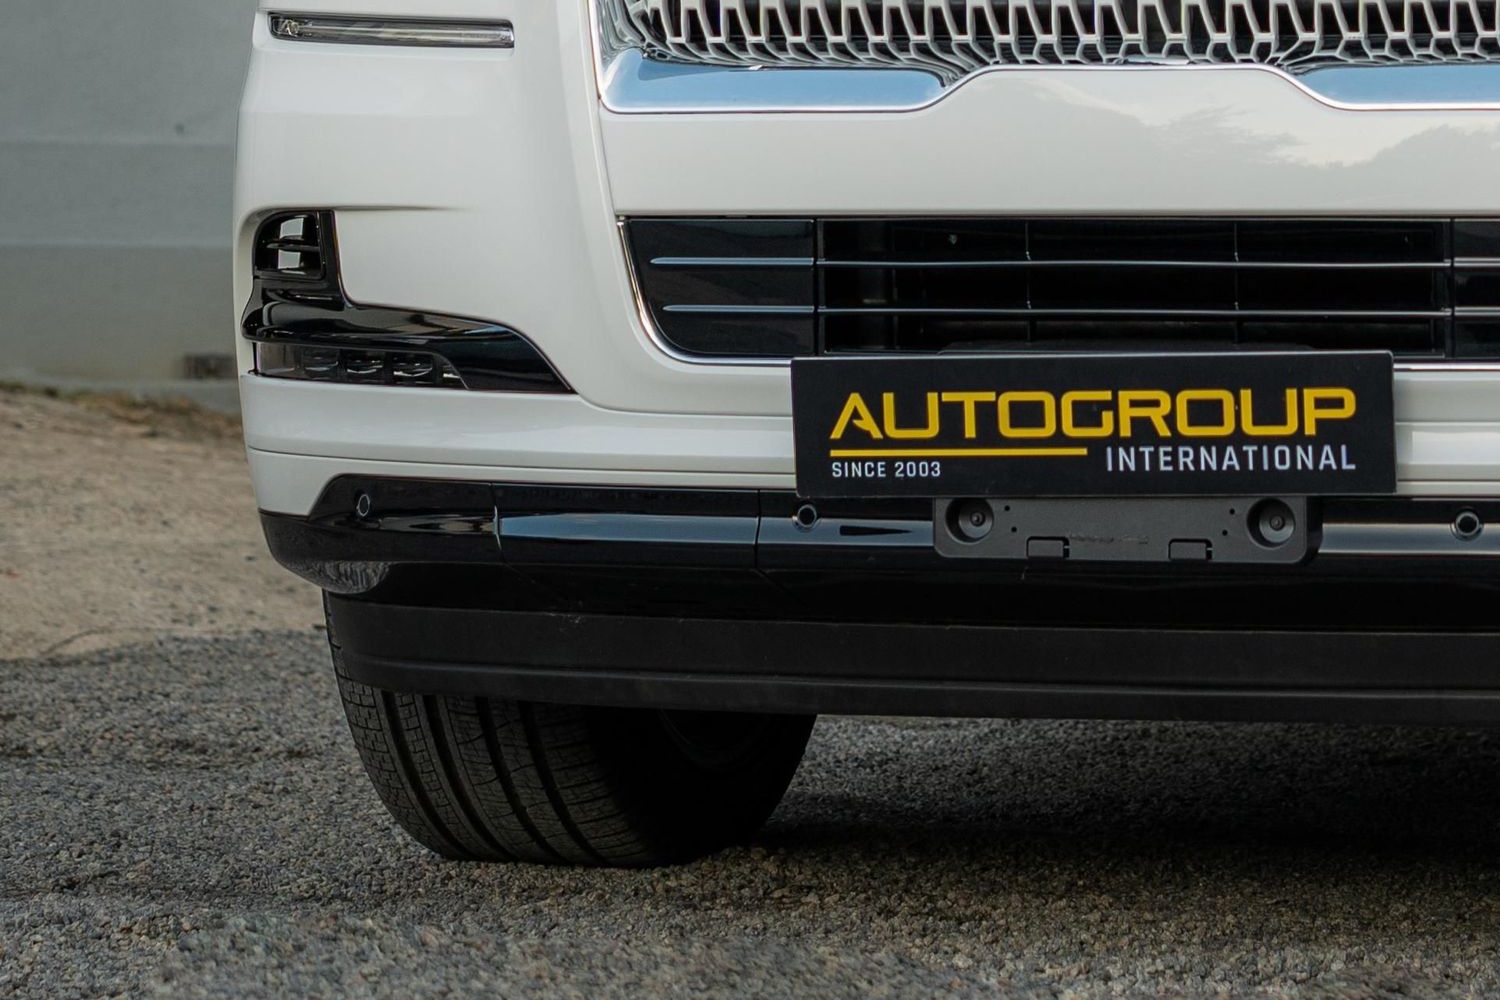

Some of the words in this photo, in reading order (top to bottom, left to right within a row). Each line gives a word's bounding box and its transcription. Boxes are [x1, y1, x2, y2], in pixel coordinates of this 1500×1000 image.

[830, 387, 1357, 440] AUTOGROUP
[831, 461, 887, 478] SINCE
[895, 461, 941, 477] 2003
[1106, 444, 1356, 472] INTERNATIONAL
